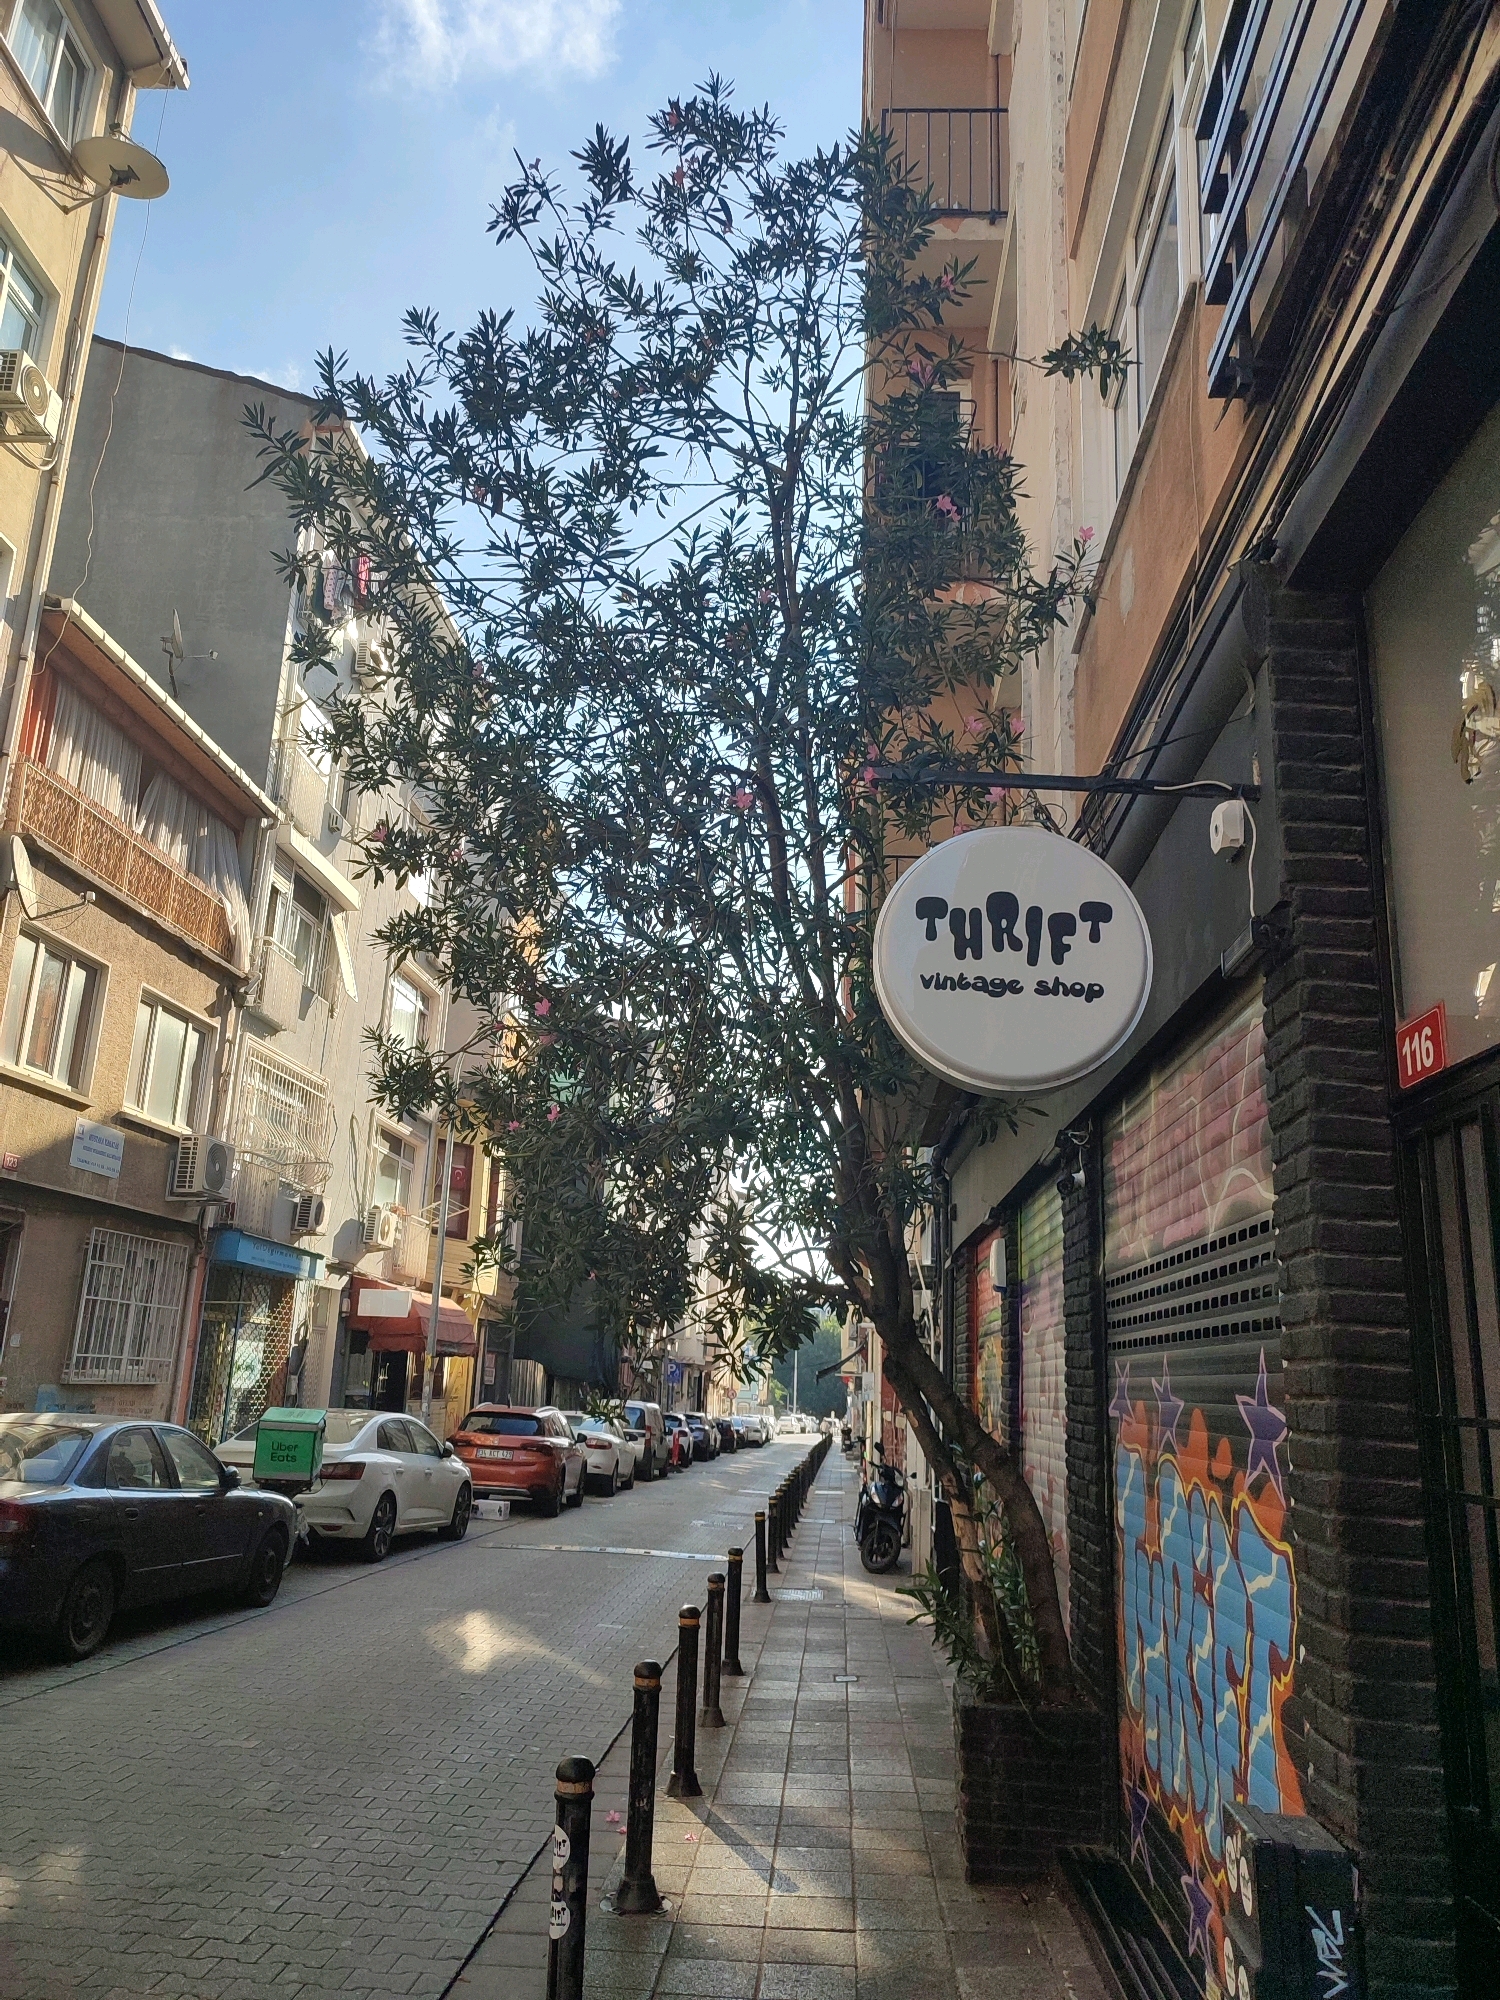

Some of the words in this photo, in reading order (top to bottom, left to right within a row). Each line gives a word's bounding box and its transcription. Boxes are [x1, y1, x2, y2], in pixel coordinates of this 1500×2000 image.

[915, 891, 1113, 966] THRIFT
[919, 972, 1024, 998] vintage
[1034, 976, 1105, 1003] shop
[1402, 1026, 1434, 1076] 116
[6, 1156, 18, 1168] 123
[667, 1364, 676, 1375] P
[271, 1441, 299, 1452] Uber
[270, 1452, 297, 1463] Eats
